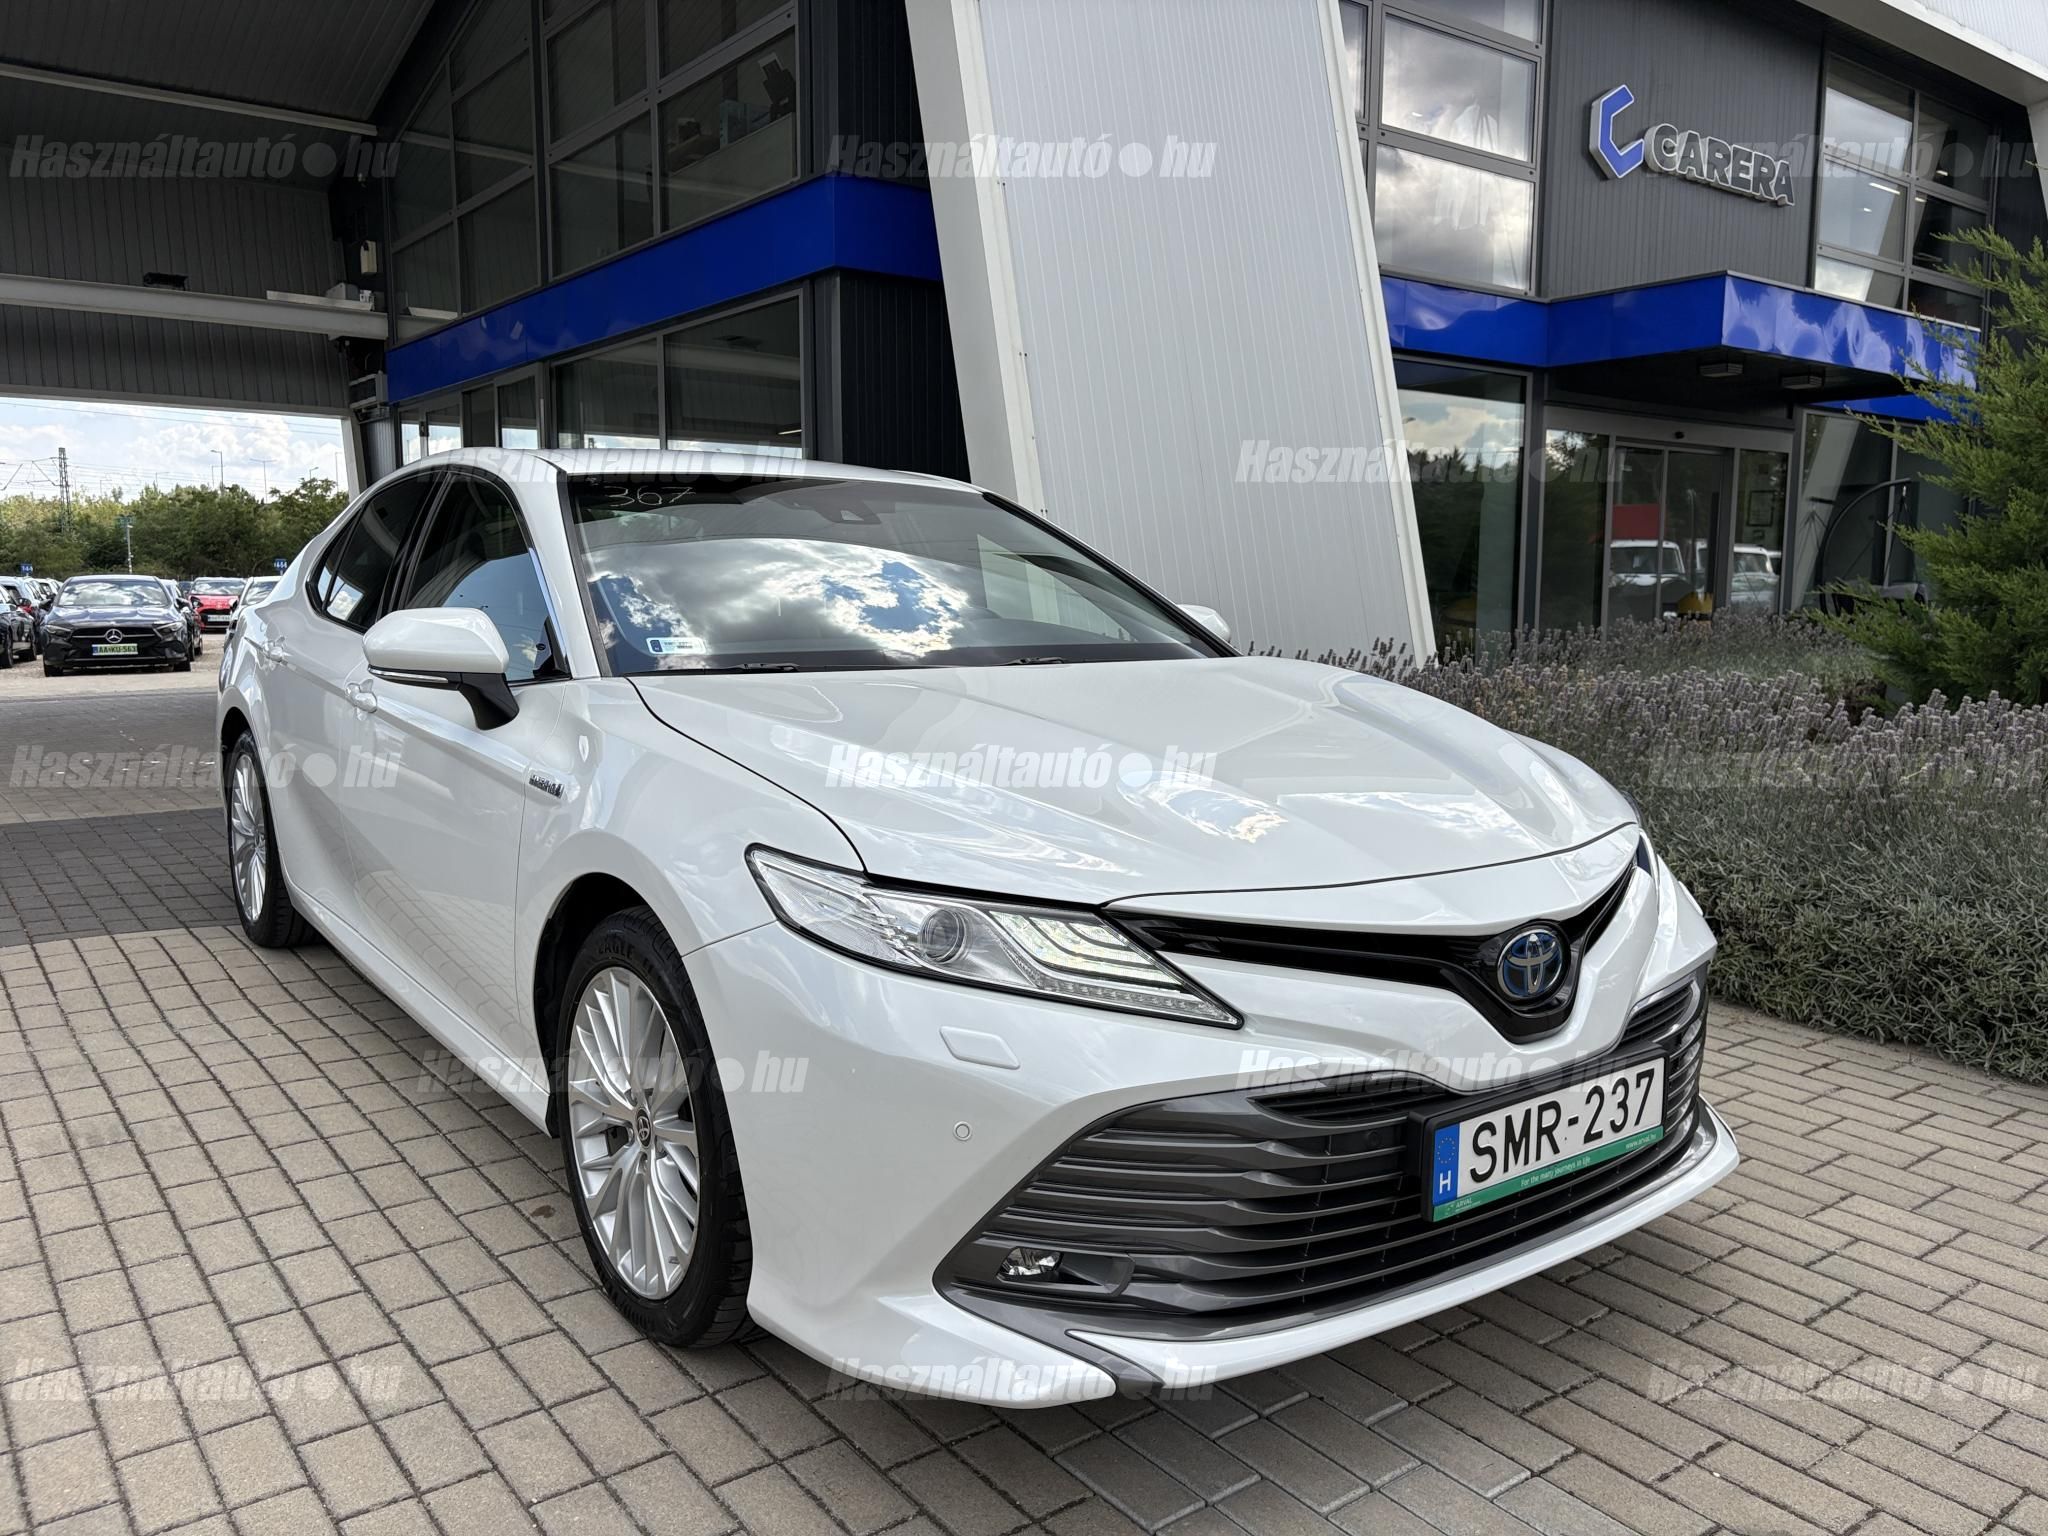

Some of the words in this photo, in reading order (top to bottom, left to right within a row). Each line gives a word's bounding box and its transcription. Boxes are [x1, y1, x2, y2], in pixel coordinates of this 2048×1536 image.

[1645, 123, 1795, 206] CARERA
[604, 485, 697, 507] 367
[1470, 1067, 1656, 1184] SMR-237
[1439, 1170, 1452, 1194] H
[1521, 1178, 1530, 1188] For
[1531, 1175, 1540, 1184] the
